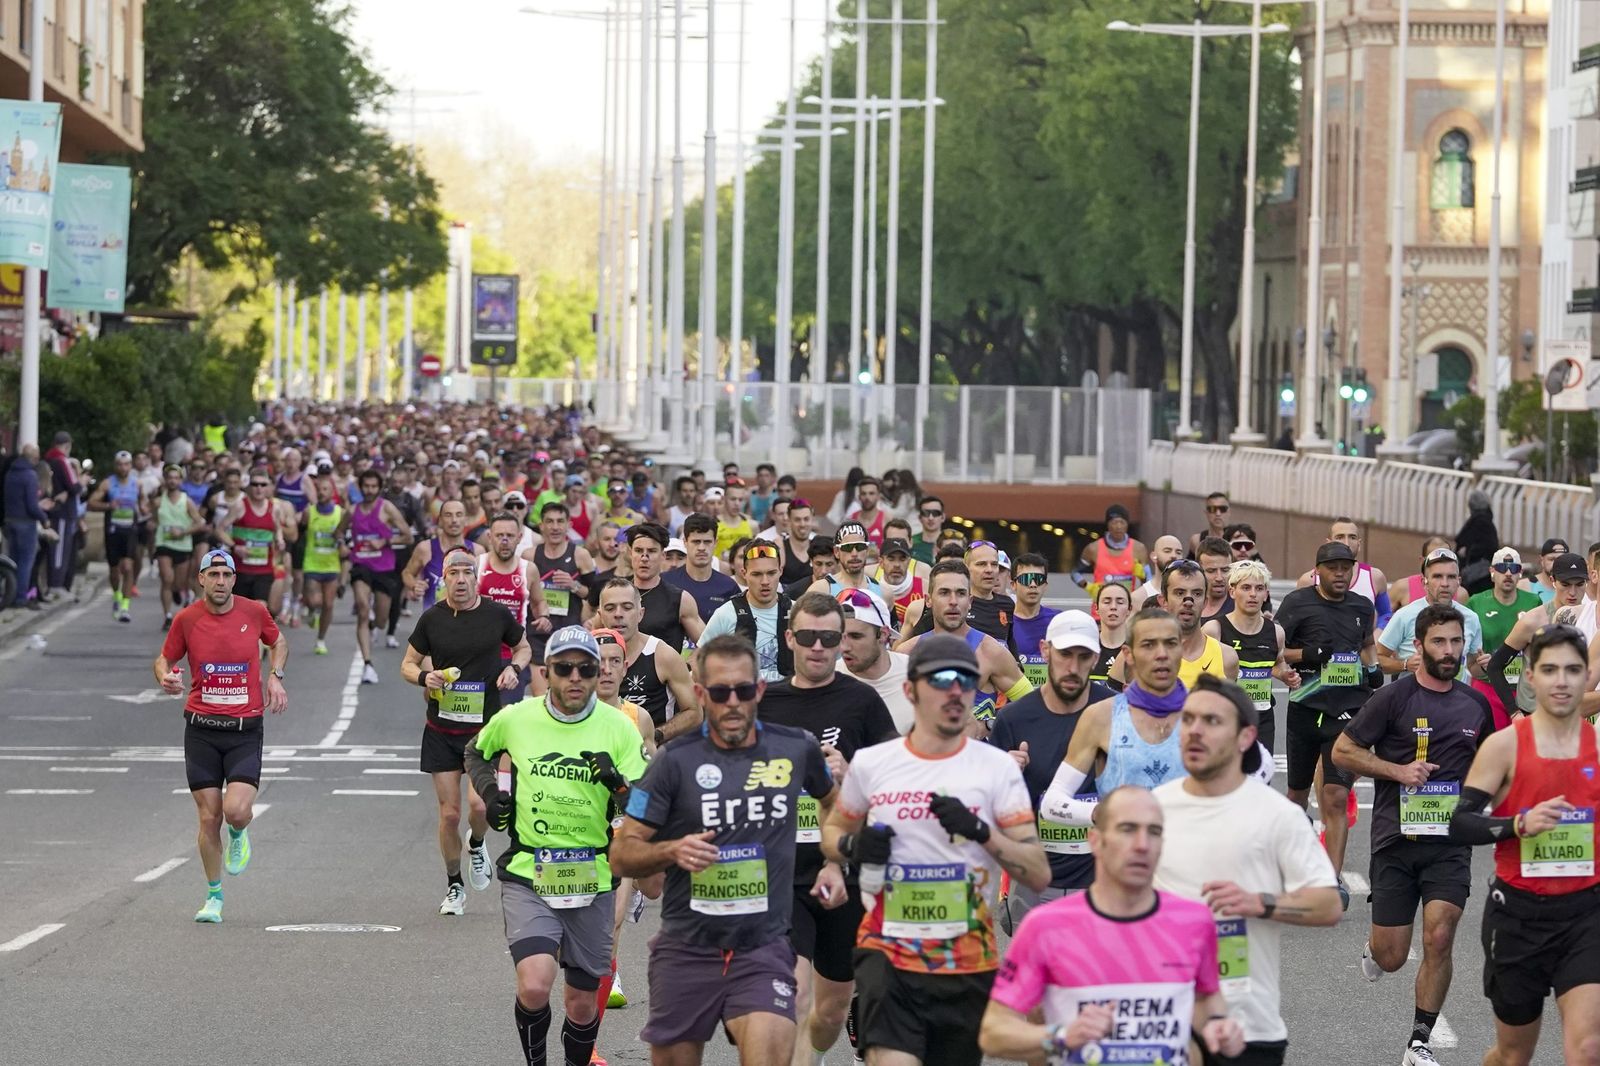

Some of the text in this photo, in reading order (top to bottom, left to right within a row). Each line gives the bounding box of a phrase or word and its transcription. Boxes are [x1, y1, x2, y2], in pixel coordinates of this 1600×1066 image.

[1027, 676, 1047, 685] EVIN
[451, 703, 470, 713] JAVI
[197, 714, 237, 727] WONG
[1421, 785, 1453, 793] ZURICH
[1422, 801, 1440, 809] 2290
[1401, 811, 1453, 822] JONATHA
[1548, 831, 1569, 841] 1537
[1532, 843, 1584, 860] ÁLVARO
[557, 868, 576, 878] 2035
[716, 869, 739, 880] 2242
[908, 867, 956, 879] ZURICH
[534, 882, 599, 895] PAULO NUNES
[692, 881, 766, 898] FRANCISCO
[902, 905, 948, 920] KRIKO
[1104, 1020, 1180, 1041] EJORA
[1107, 1047, 1163, 1062] ZURICH
